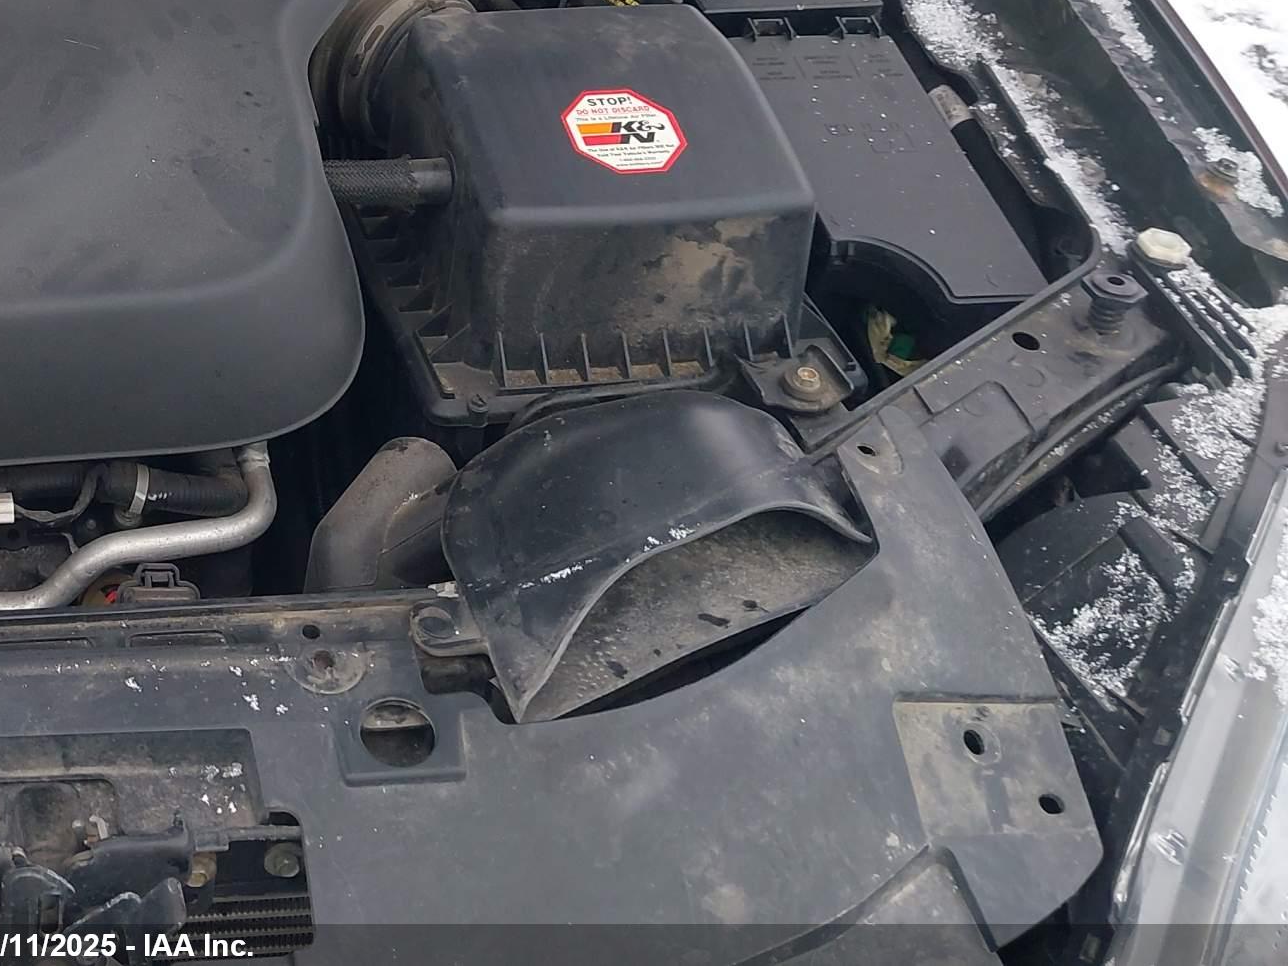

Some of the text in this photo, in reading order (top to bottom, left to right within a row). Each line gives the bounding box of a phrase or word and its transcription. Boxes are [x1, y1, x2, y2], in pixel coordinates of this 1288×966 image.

[587, 97, 632, 107] STOP!
[576, 105, 650, 116] DO NOT DISCARD
[611, 120, 665, 144] K&N
